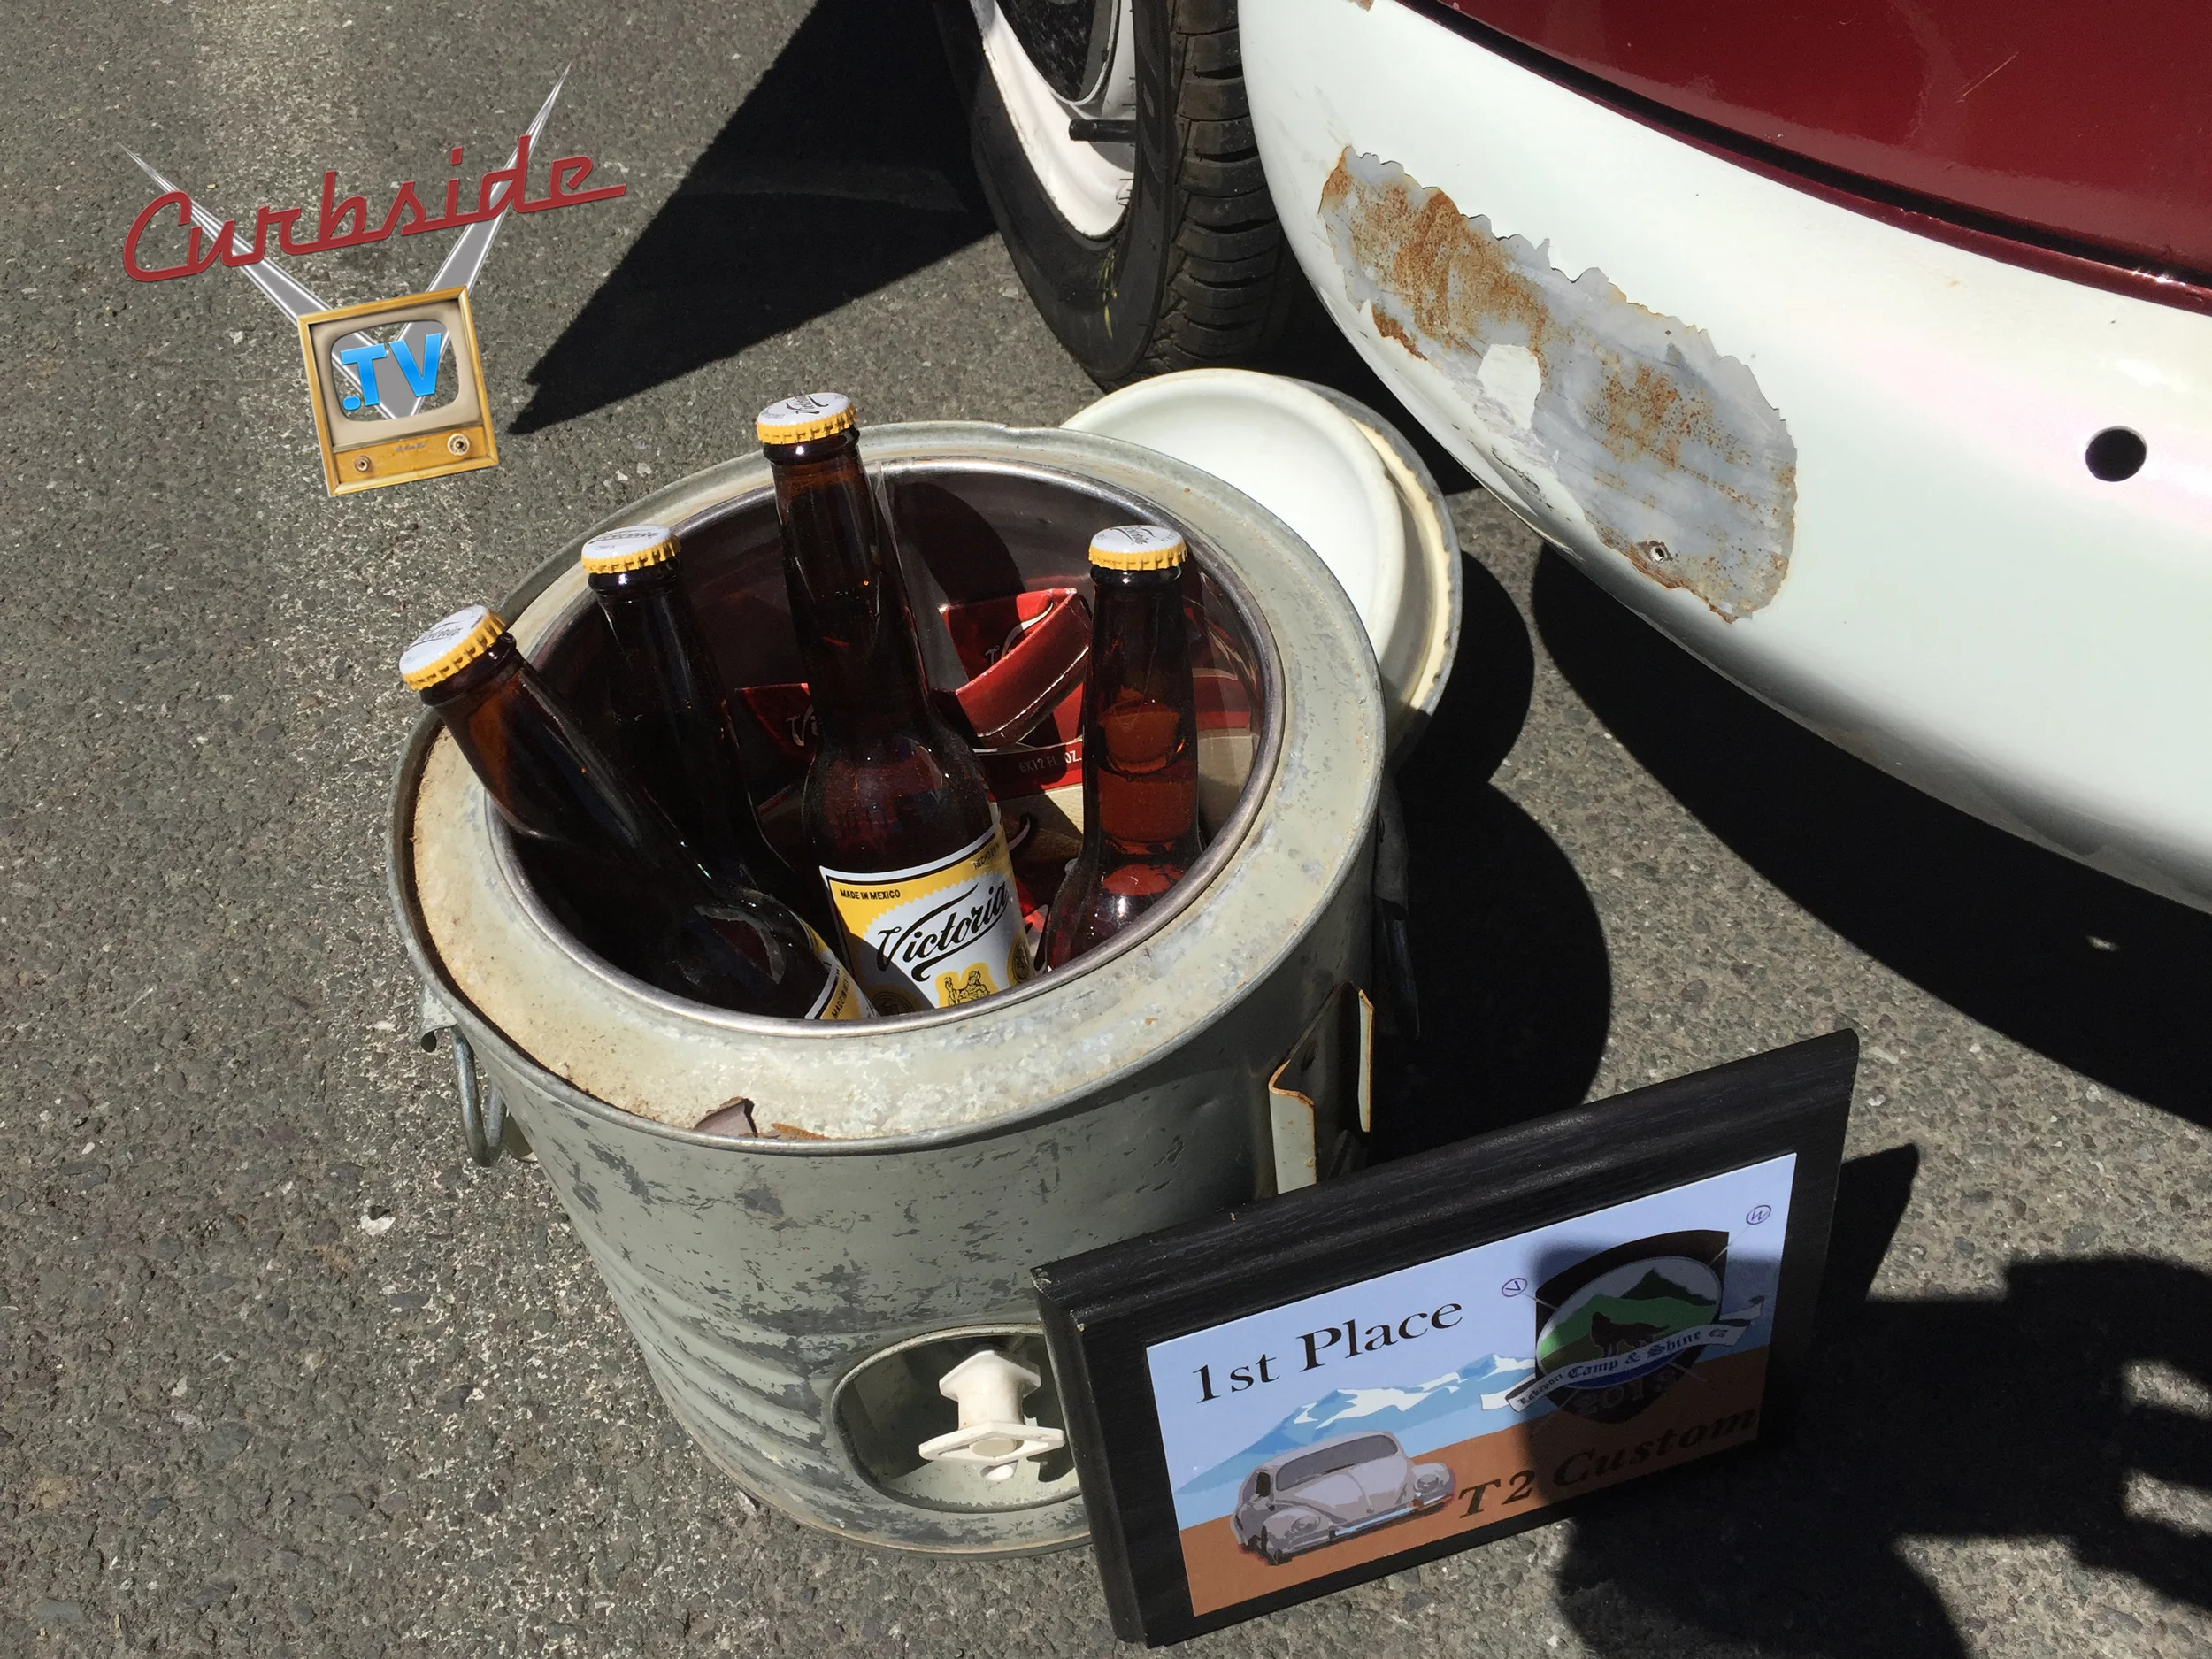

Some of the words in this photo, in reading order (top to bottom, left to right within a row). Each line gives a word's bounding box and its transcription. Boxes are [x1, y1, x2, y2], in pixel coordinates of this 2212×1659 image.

[1064, 749, 1083, 764] OZ.
[840, 888, 860, 900] MADE
[860, 891, 870, 900] IN
[869, 888, 901, 900] MEXICO
[876, 881, 1010, 982] Victoria
[1193, 1354, 1281, 1404] 1st
[1295, 1302, 1463, 1372] Place
[1567, 1359, 1619, 1379] Camp
[1624, 1350, 1640, 1364] &
[1647, 1329, 1701, 1361] Shine
[1553, 1408, 1757, 1487] Custom
